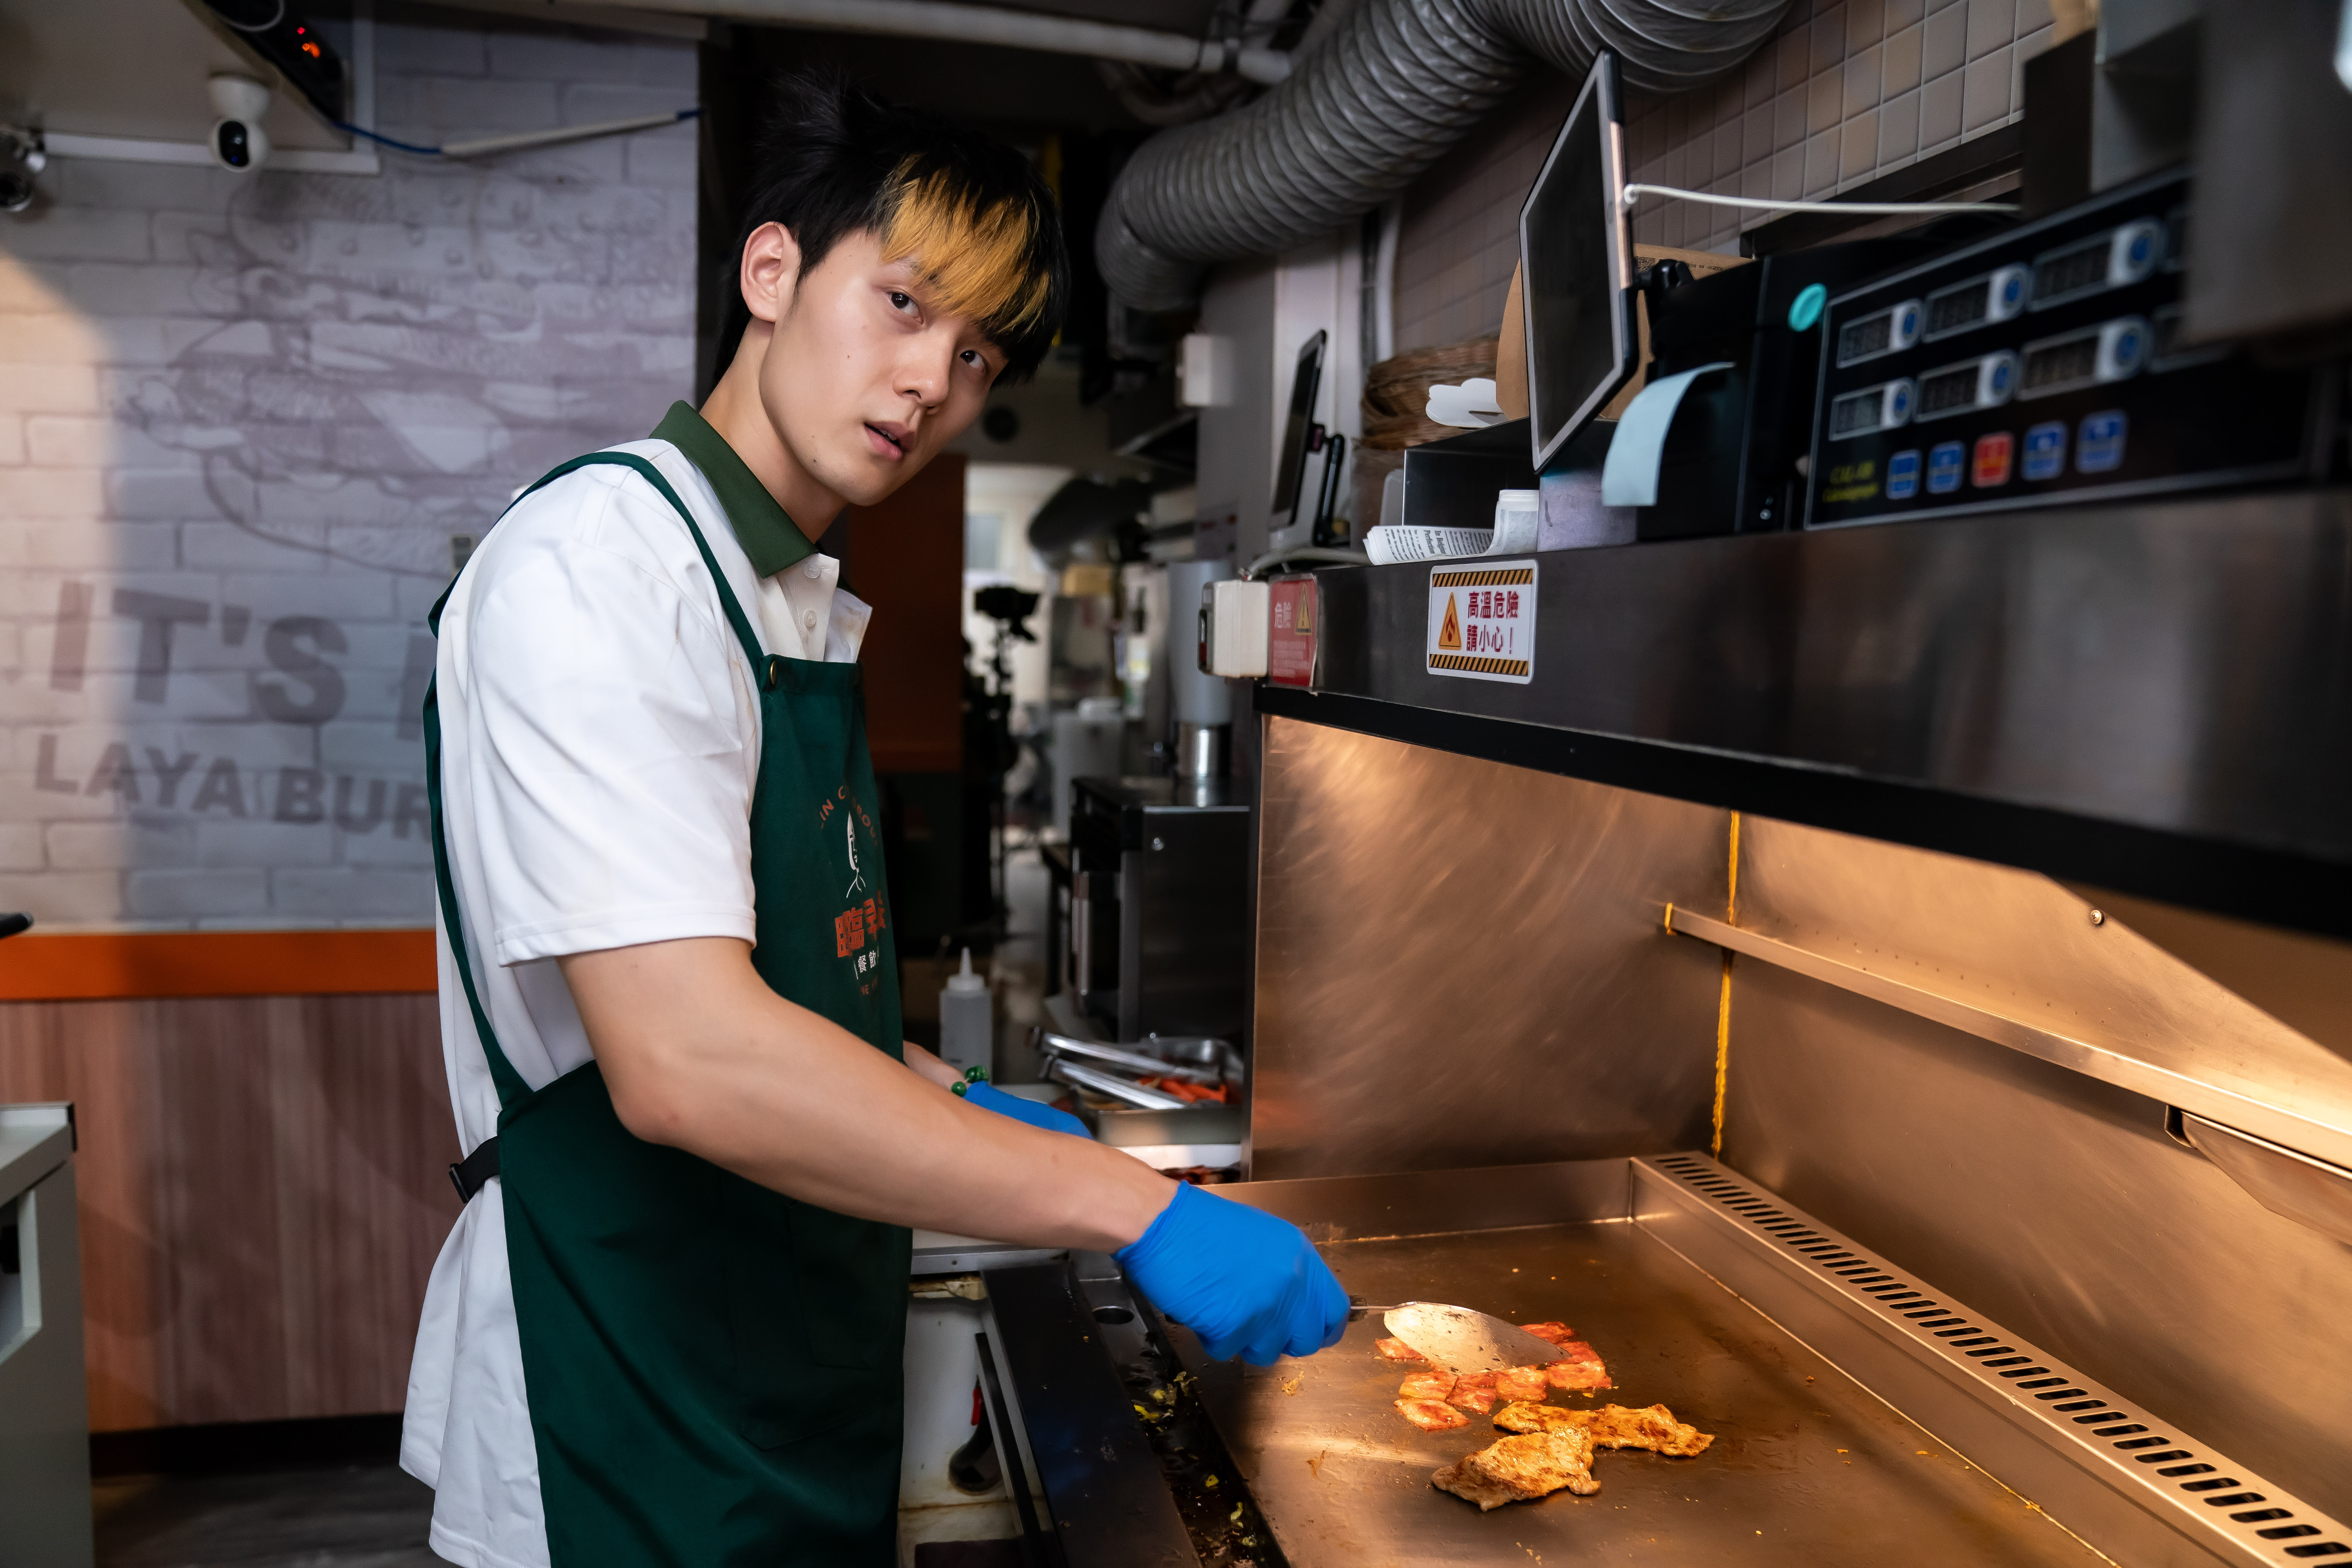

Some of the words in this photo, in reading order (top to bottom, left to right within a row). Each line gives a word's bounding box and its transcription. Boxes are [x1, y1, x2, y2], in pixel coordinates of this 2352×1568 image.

[1467, 591, 1519, 619] 高溫危險
[49, 580, 349, 726] IT'S
[34, 734, 247, 818] LAYA
